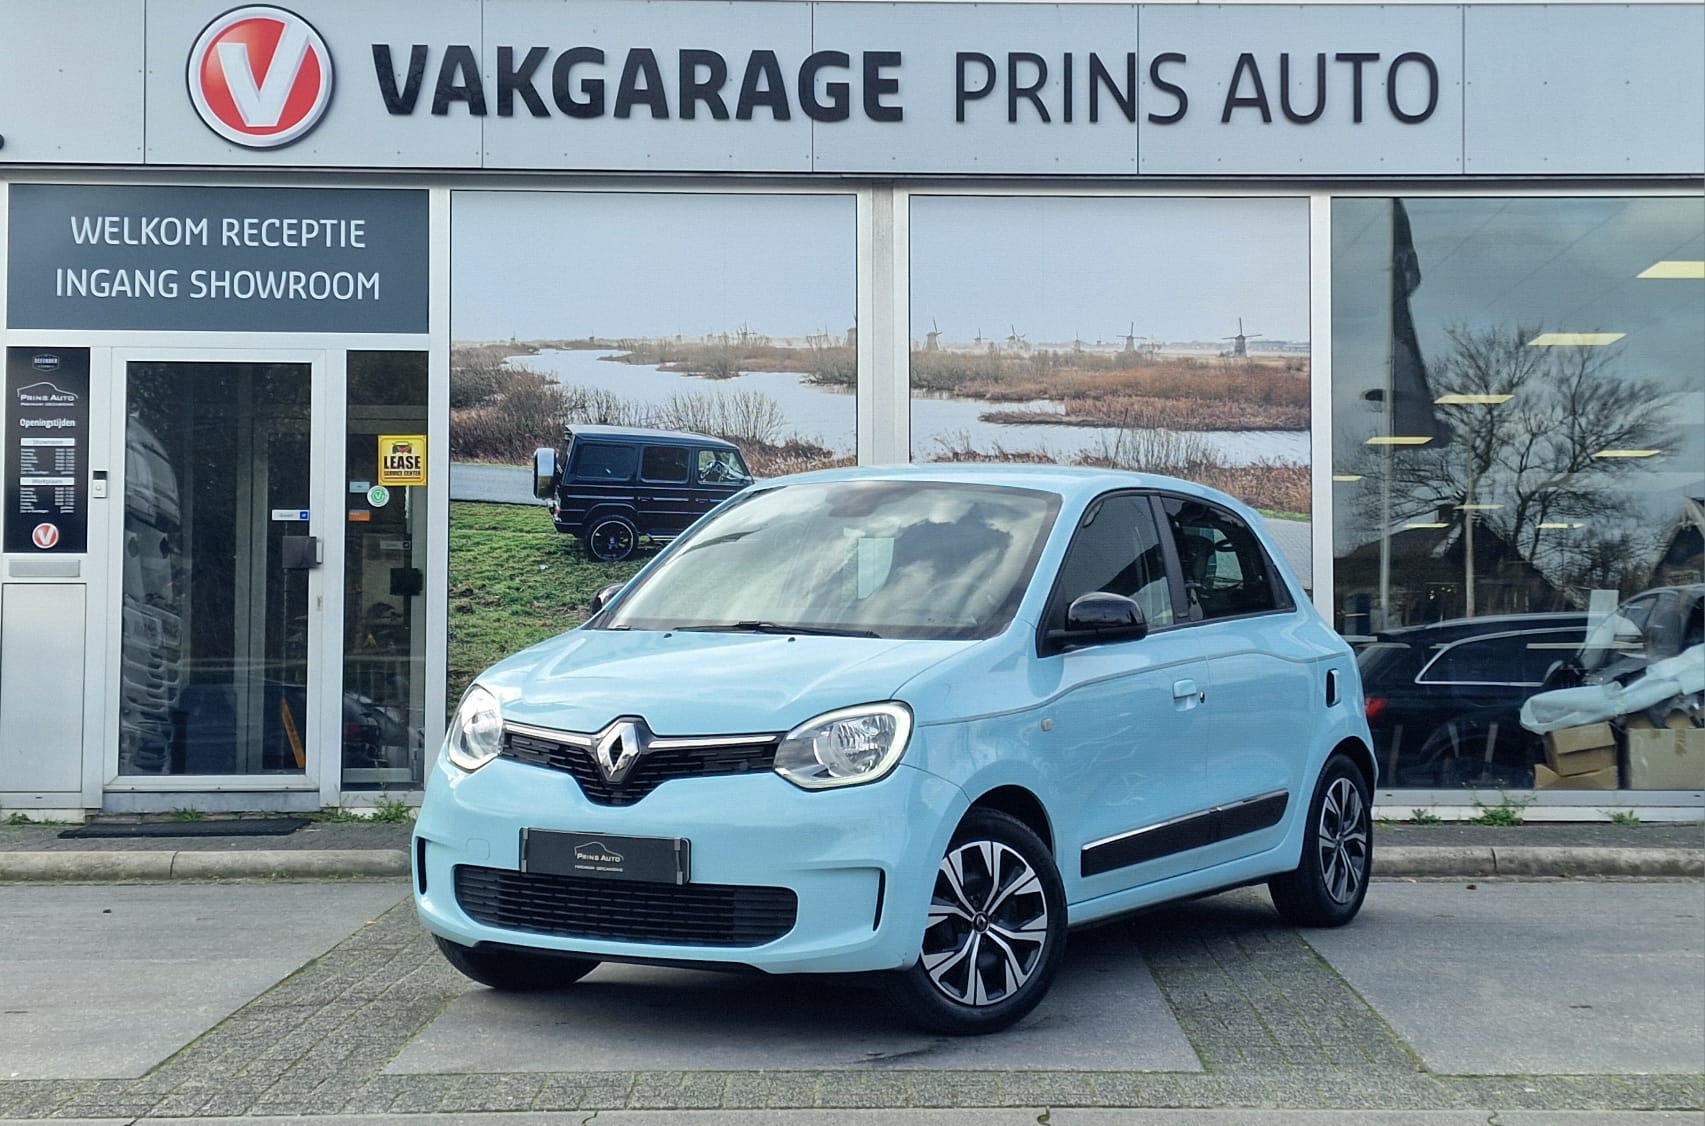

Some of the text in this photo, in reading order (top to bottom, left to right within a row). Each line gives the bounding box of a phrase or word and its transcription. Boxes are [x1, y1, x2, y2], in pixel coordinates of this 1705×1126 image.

[217, 18, 311, 128] V
[372, 44, 1439, 125] VAKGARAGE PRINS AUTO
[70, 216, 366, 248] WELKOM RECEPTIE
[56, 268, 380, 300] INGANG SHOWROOM
[20, 418, 76, 429] Openingstijden
[383, 455, 421, 470] LEASE
